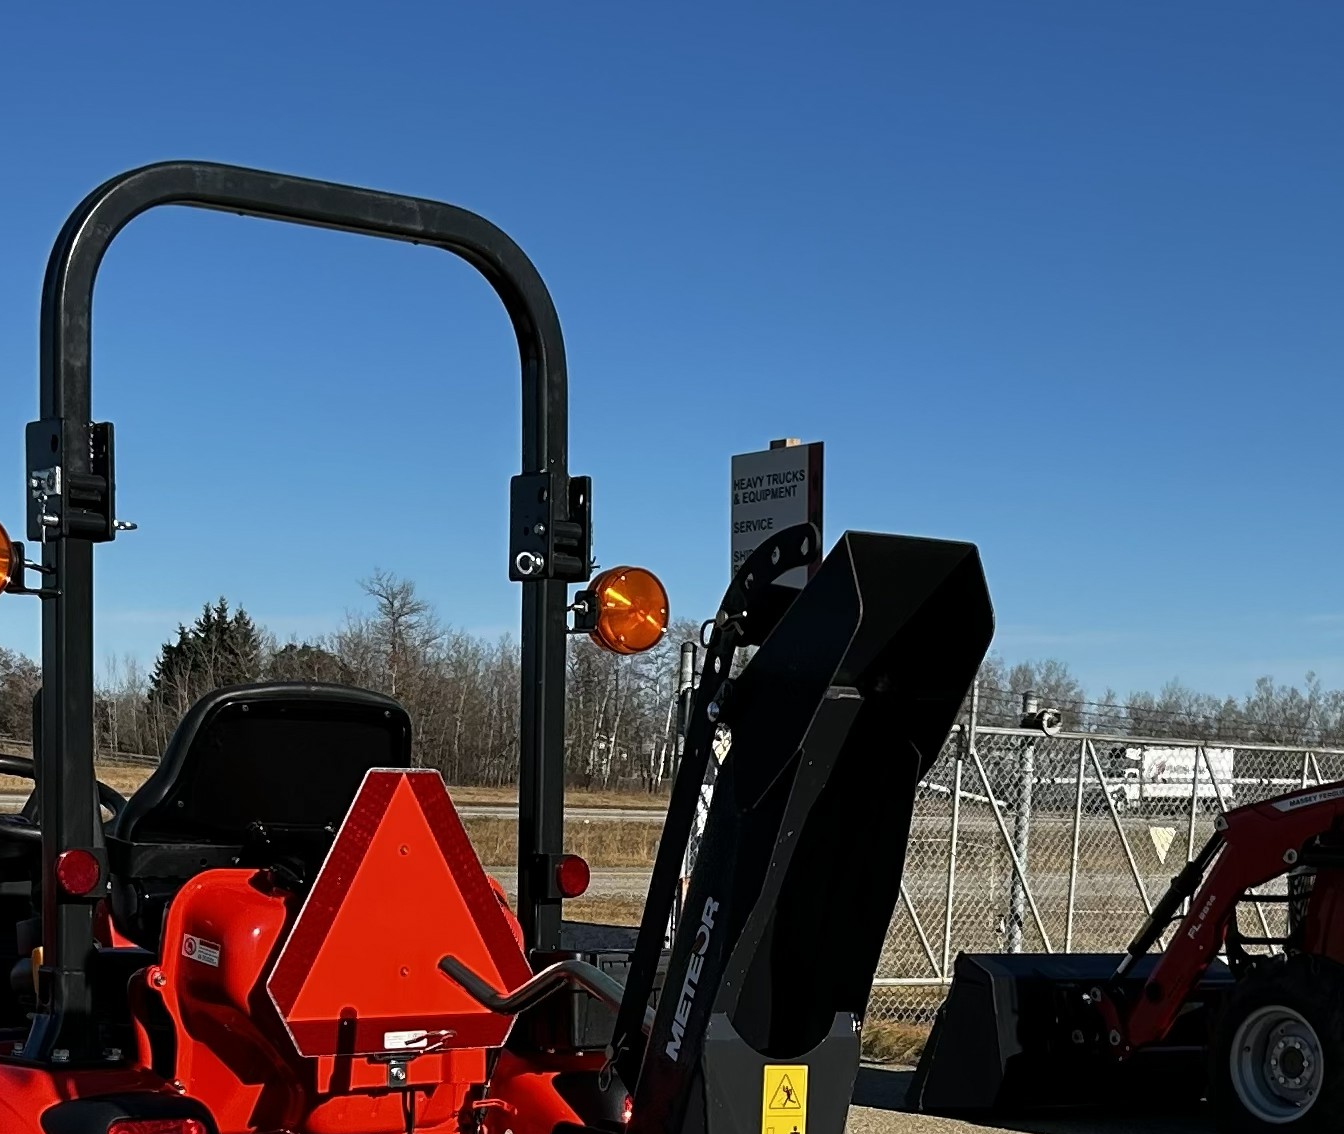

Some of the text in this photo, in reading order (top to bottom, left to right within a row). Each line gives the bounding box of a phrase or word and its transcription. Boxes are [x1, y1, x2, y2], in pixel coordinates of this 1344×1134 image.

[733, 469, 805, 491] HEAVY TRUCKS
[733, 485, 797, 505] & EQUIPMENT
[733, 518, 773, 534] SERVICE
[665, 896, 720, 1063] METEOR
